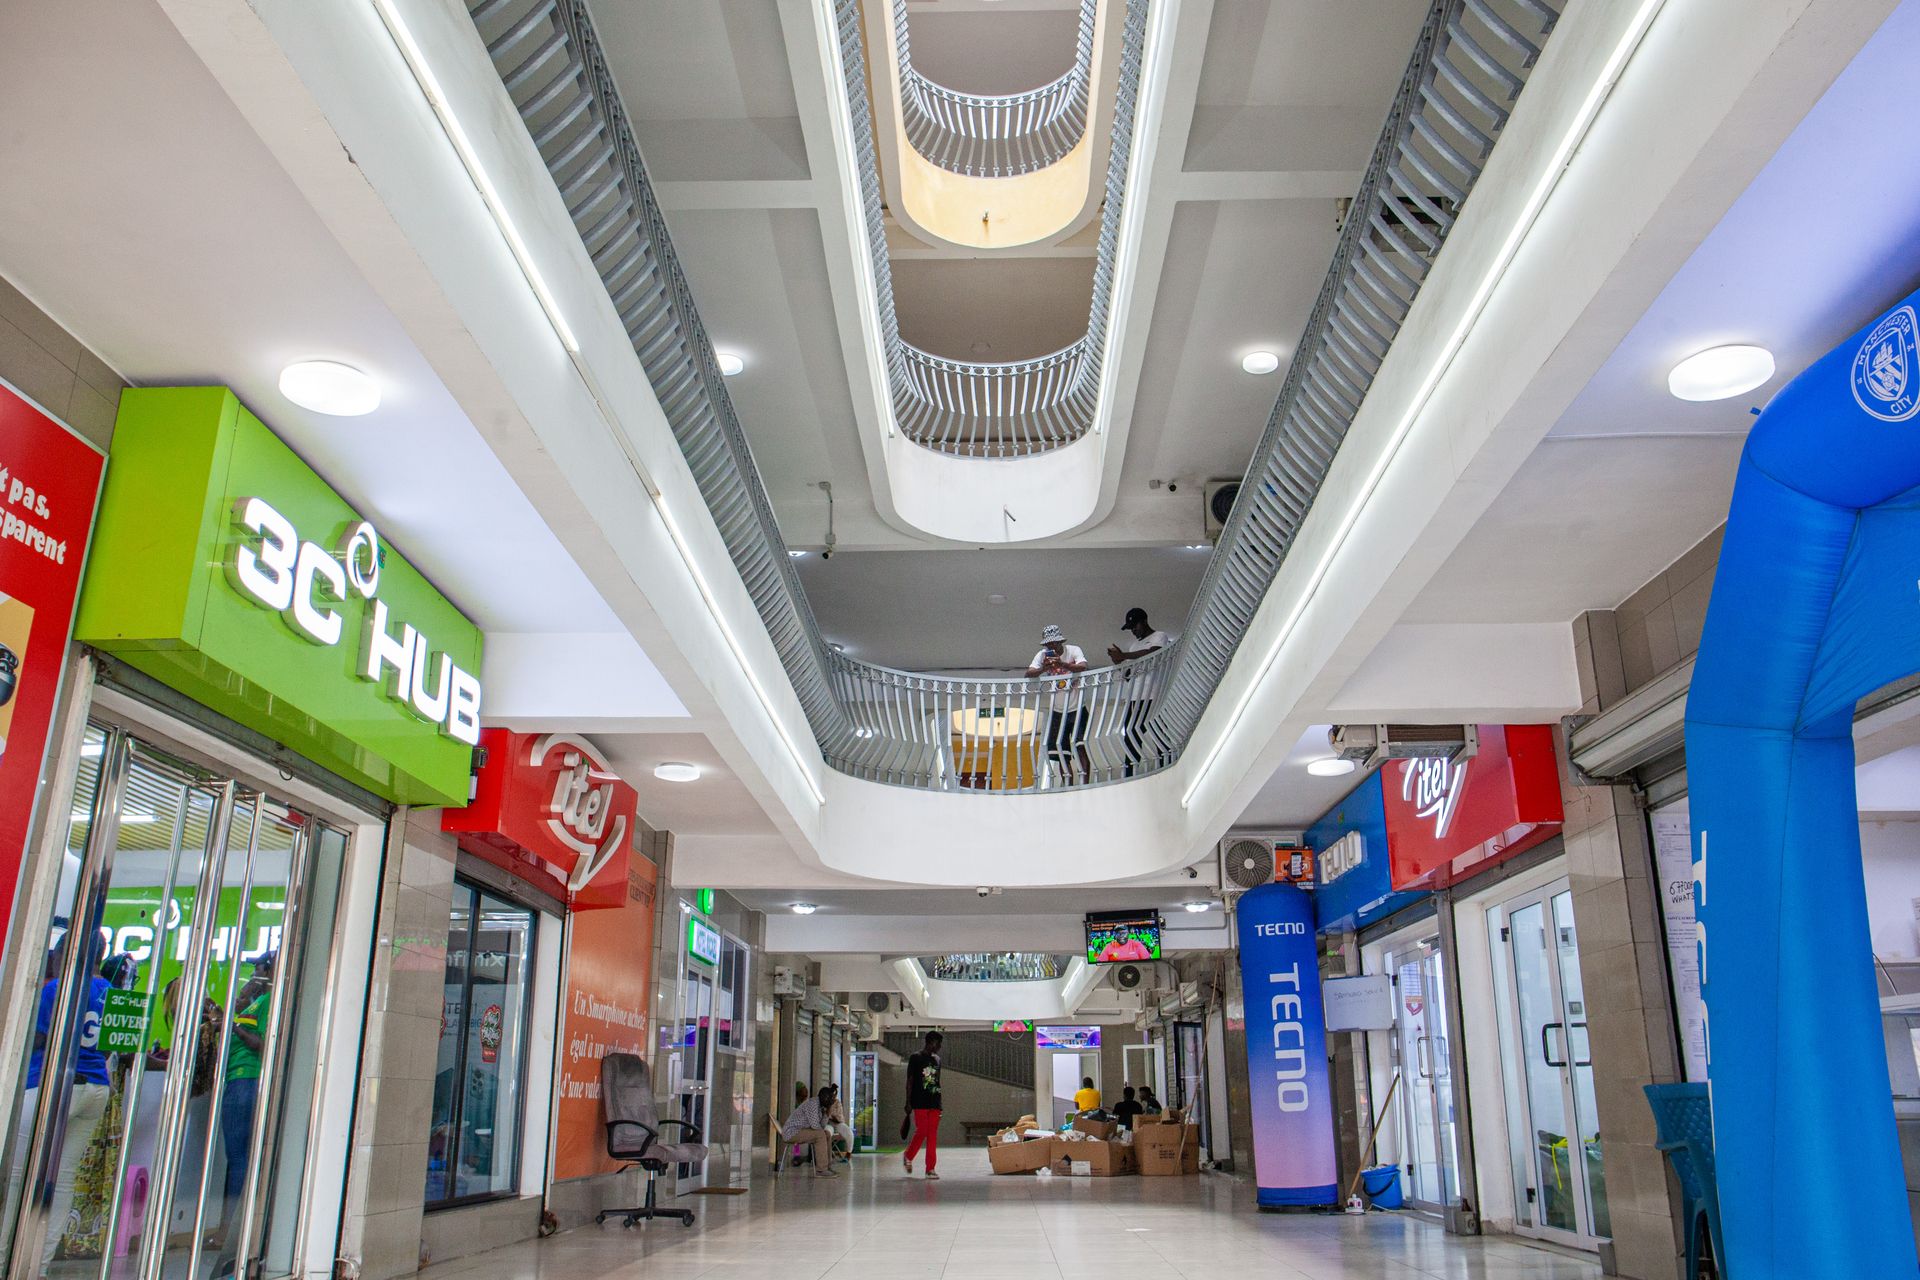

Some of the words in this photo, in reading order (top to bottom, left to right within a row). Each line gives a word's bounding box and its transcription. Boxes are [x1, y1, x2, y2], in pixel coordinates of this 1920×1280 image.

[1858, 314, 1911, 365] MANCHESTER
[1890, 395, 1912, 414] CITY
[236, 497, 347, 646] 3C
[362, 598, 482, 746] HUB
[551, 751, 614, 839] itel
[1416, 757, 1449, 810] itel
[1317, 830, 1363, 885] TECNO
[1255, 922, 1305, 937] TECNO
[111, 995, 125, 1006] 3C
[574, 990, 586, 1016] Un
[587, 994, 626, 1028] Smartphone
[104, 1013, 150, 1029] OUVERT
[109, 1031, 142, 1046] OPEN
[1269, 962, 1309, 1112] TECNO
[570, 1032, 588, 1064] égal
[588, 1034, 594, 1059] à
[594, 1043, 605, 1060] un
[560, 1072, 584, 1099] d'une
